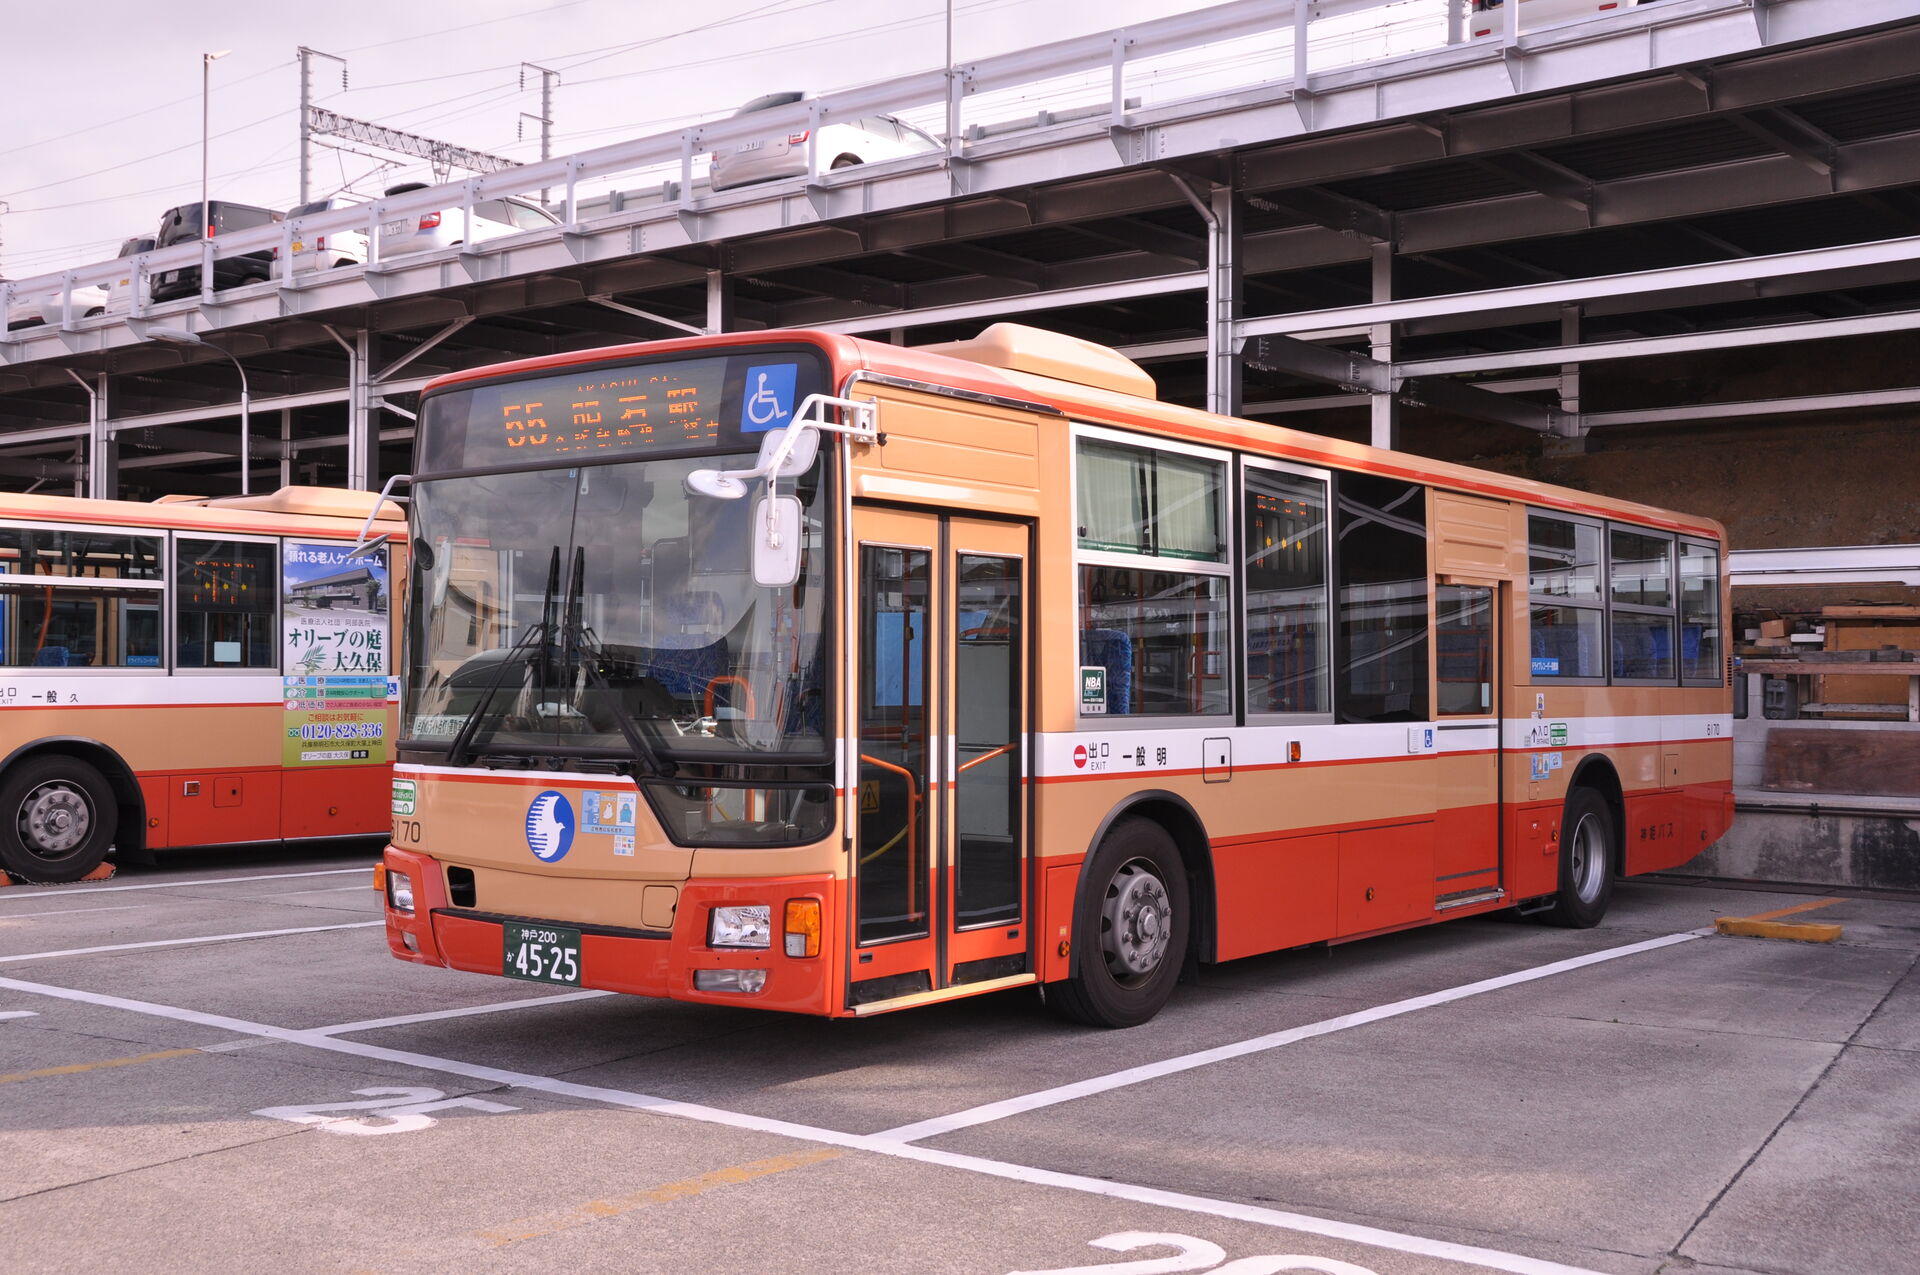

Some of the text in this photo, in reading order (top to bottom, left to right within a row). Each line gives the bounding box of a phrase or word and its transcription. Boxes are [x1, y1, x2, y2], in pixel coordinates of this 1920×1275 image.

[288, 627, 382, 650] オリーブの庭
[332, 651, 382, 673] 大久保
[1085, 676, 1102, 689] NBA
[32, 690, 58, 704] 一般
[308, 713, 364, 722] ご相談はお気軽に
[301, 723, 383, 740] 0120-828-336
[1706, 723, 1720, 736] 6170
[1088, 742, 1167, 767] 出口 一般 明
[1090, 761, 1107, 771] EXIT
[506, 942, 577, 982] か 45-25
[1003, 1230, 1385, 1275] 2
